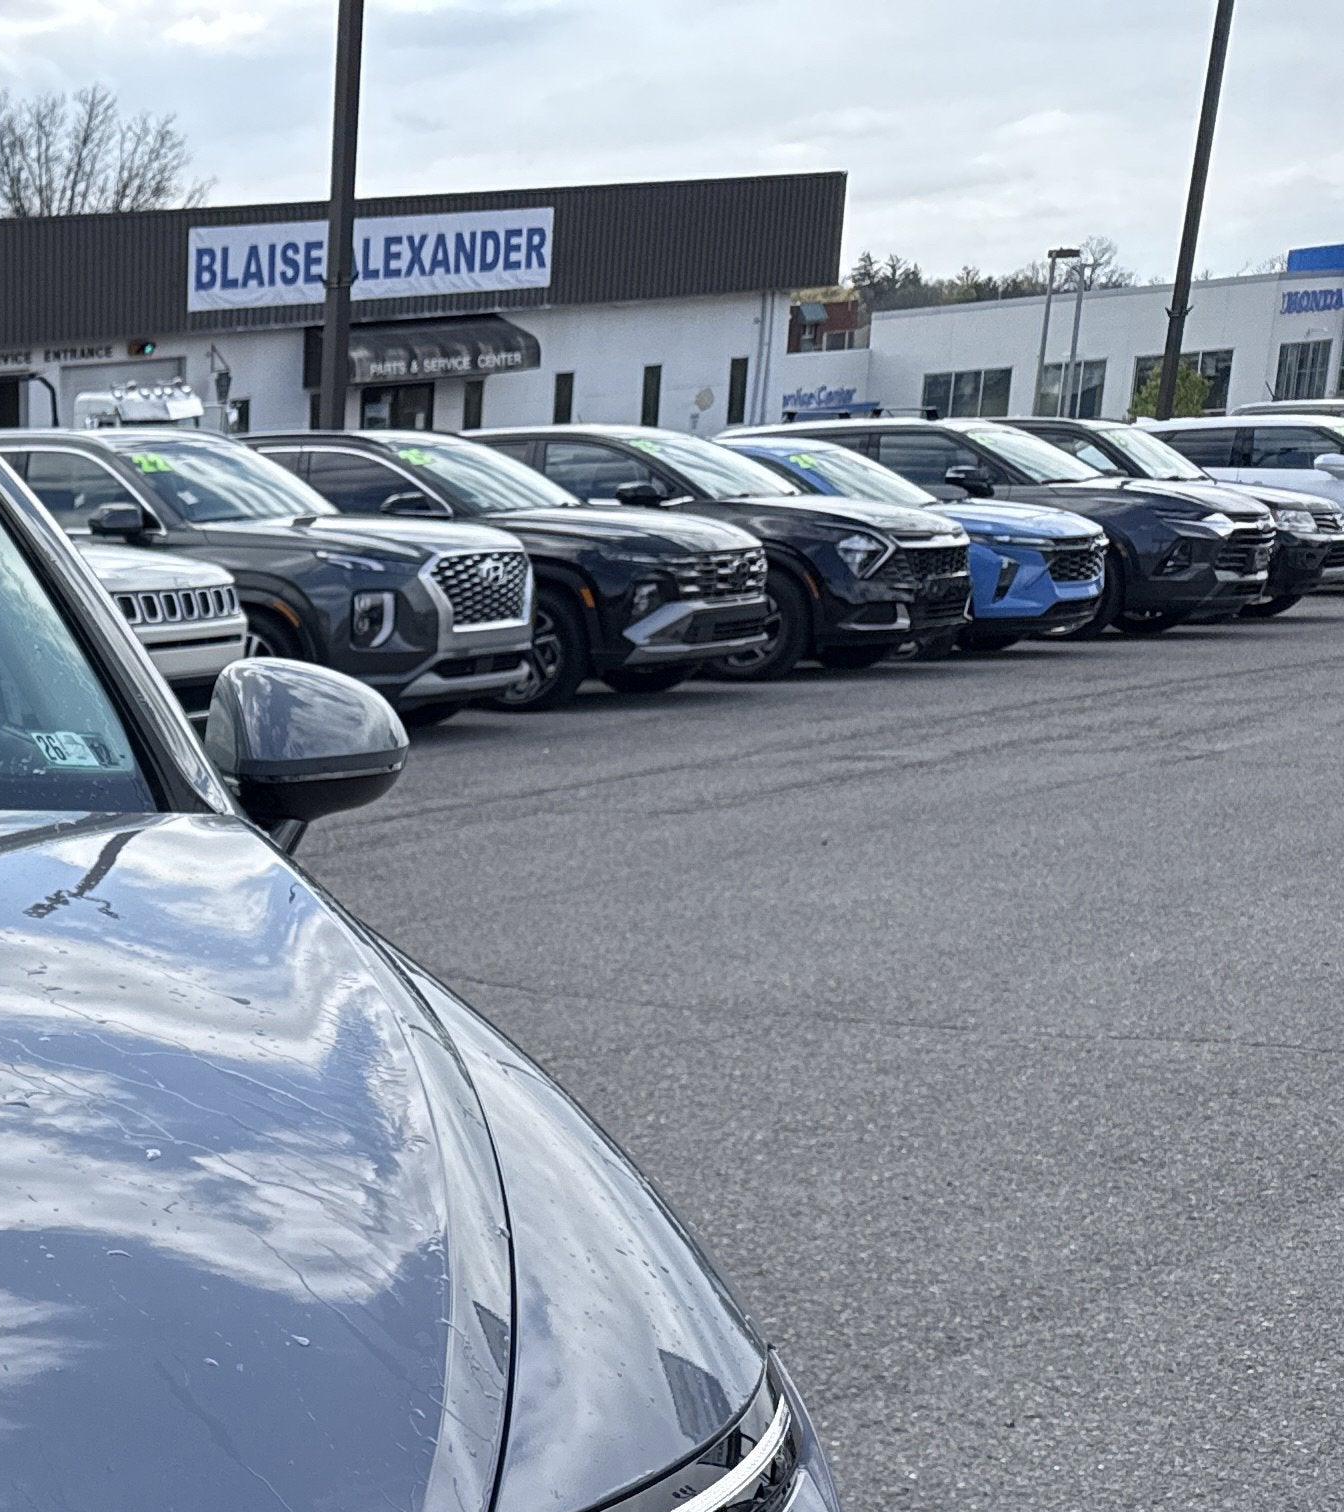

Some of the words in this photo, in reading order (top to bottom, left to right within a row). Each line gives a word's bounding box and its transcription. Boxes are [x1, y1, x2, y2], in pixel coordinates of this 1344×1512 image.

[194, 240, 325, 293] BLAISE
[353, 226, 547, 284] LEXANDER
[43, 345, 113, 364] ENTRANCE
[369, 359, 406, 376] PARTS
[410, 359, 420, 374] &
[423, 356, 472, 373] SERVICE
[477, 351, 522, 369] CENTER
[131, 452, 173, 473] 22
[35, 735, 67, 761] 26
